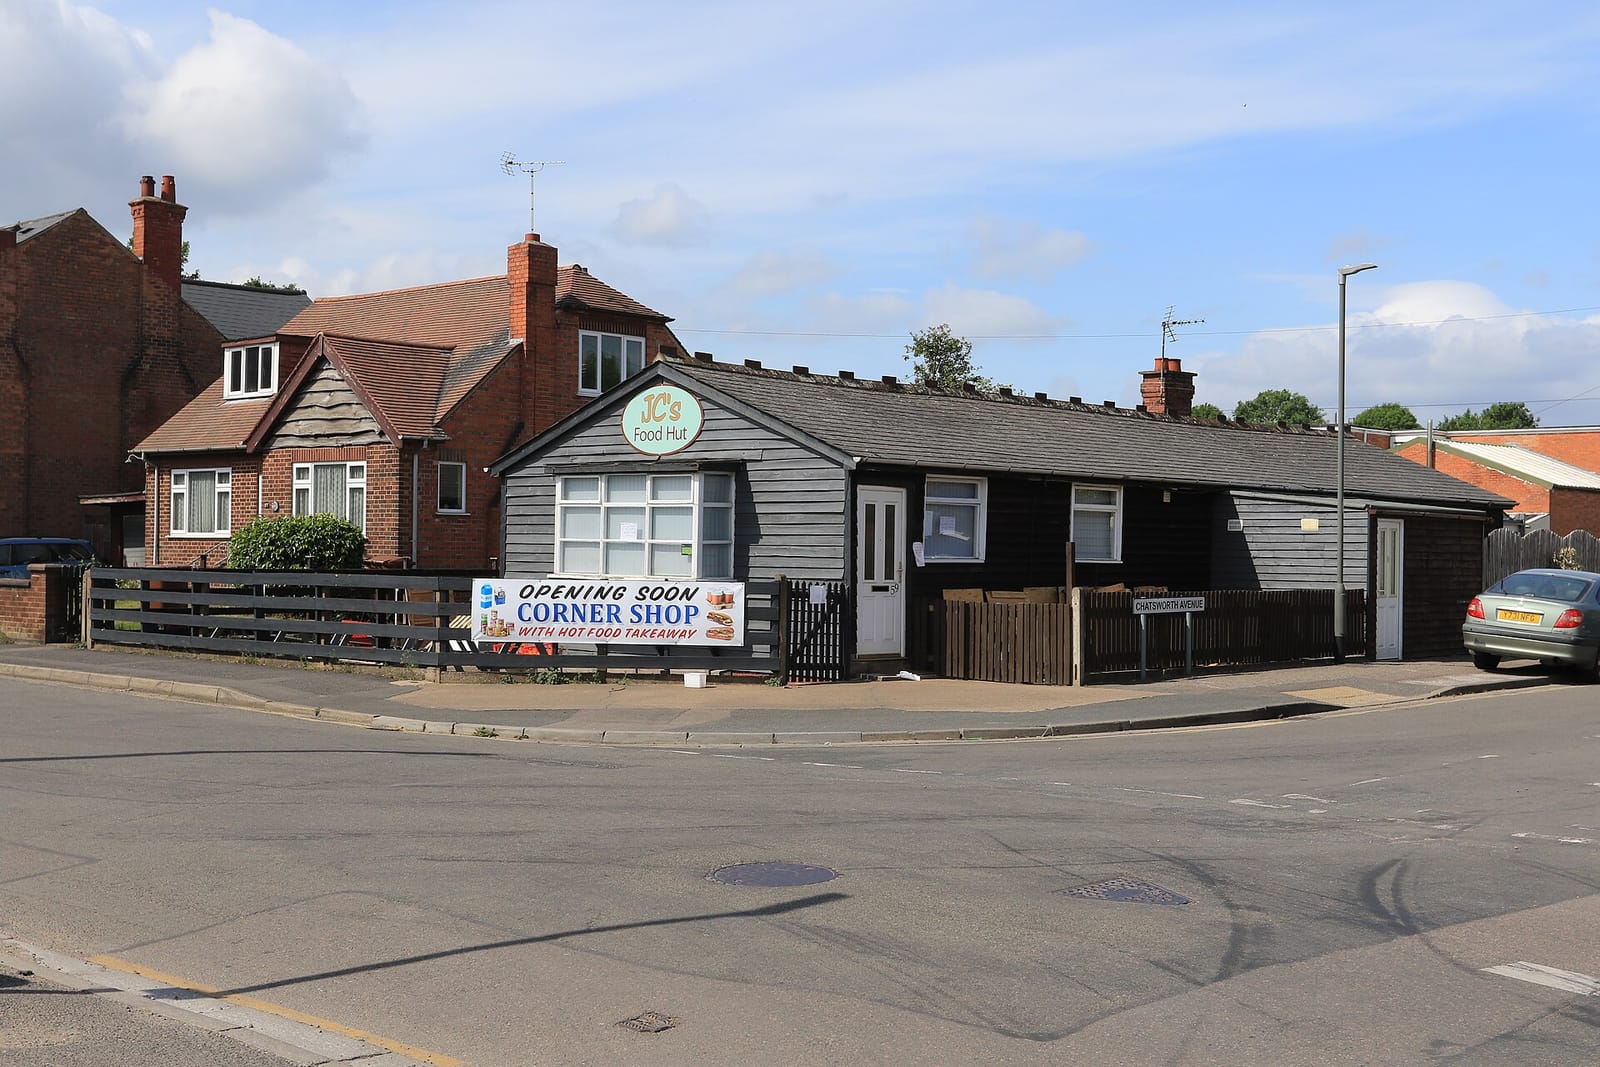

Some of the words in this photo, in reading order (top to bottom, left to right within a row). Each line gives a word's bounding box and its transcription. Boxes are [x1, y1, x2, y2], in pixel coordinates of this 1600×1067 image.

[641, 392, 682, 423] JC's
[634, 426, 663, 441] Food
[666, 425, 688, 440] Hut
[518, 584, 627, 601] OPENING
[634, 586, 700, 602] SOON
[890, 584, 899, 595] 59
[517, 602, 623, 624] CORNER
[629, 604, 699, 625] SHOP
[1136, 600, 1178, 611] CHATSWORTH
[1180, 600, 1204, 608] AVENUE
[518, 626, 555, 637] WITH
[558, 627, 586, 638] HOT
[586, 627, 623, 638] FOOD
[625, 628, 698, 640] TAKEAWAY
